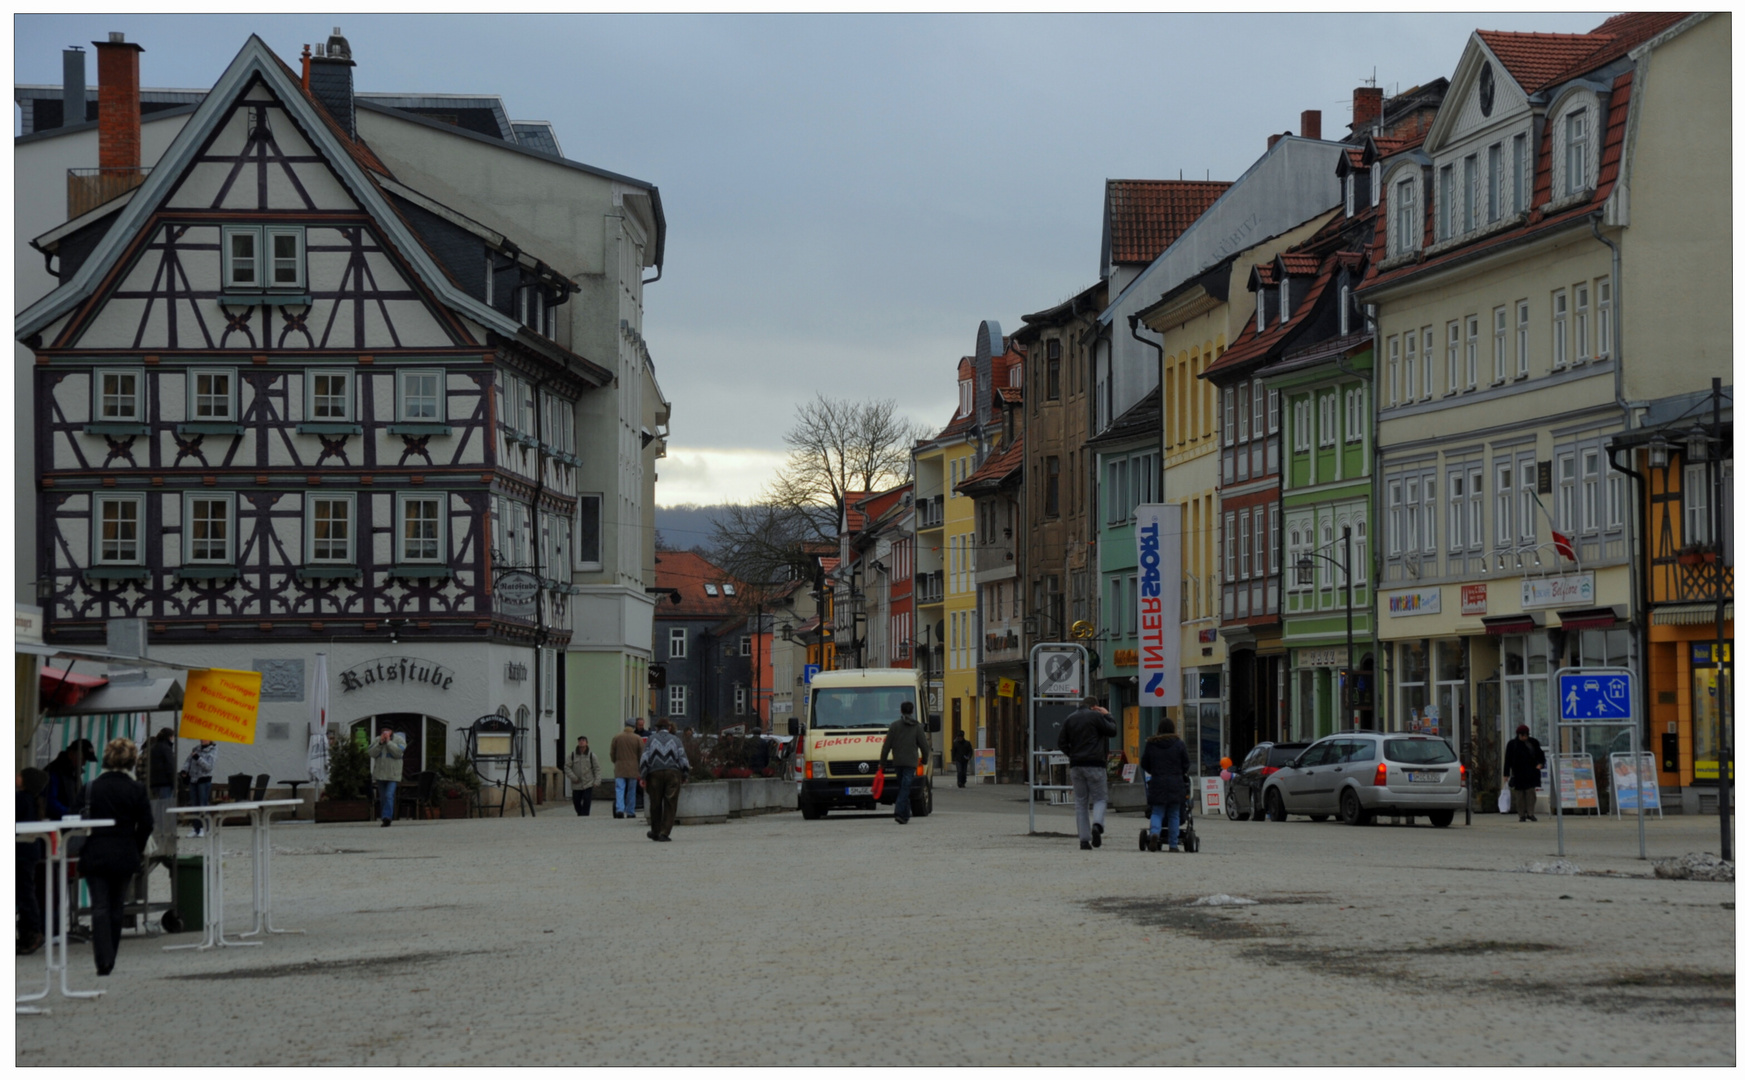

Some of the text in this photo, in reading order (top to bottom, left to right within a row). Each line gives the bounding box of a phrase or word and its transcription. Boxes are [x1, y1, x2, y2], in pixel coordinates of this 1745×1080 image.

[1048, 684, 1071, 692] ZONE
[200, 686, 255, 712] Rostbratwurst
[197, 701, 241, 723] GLÜHWEIN
[814, 736, 862, 750] Elektro
